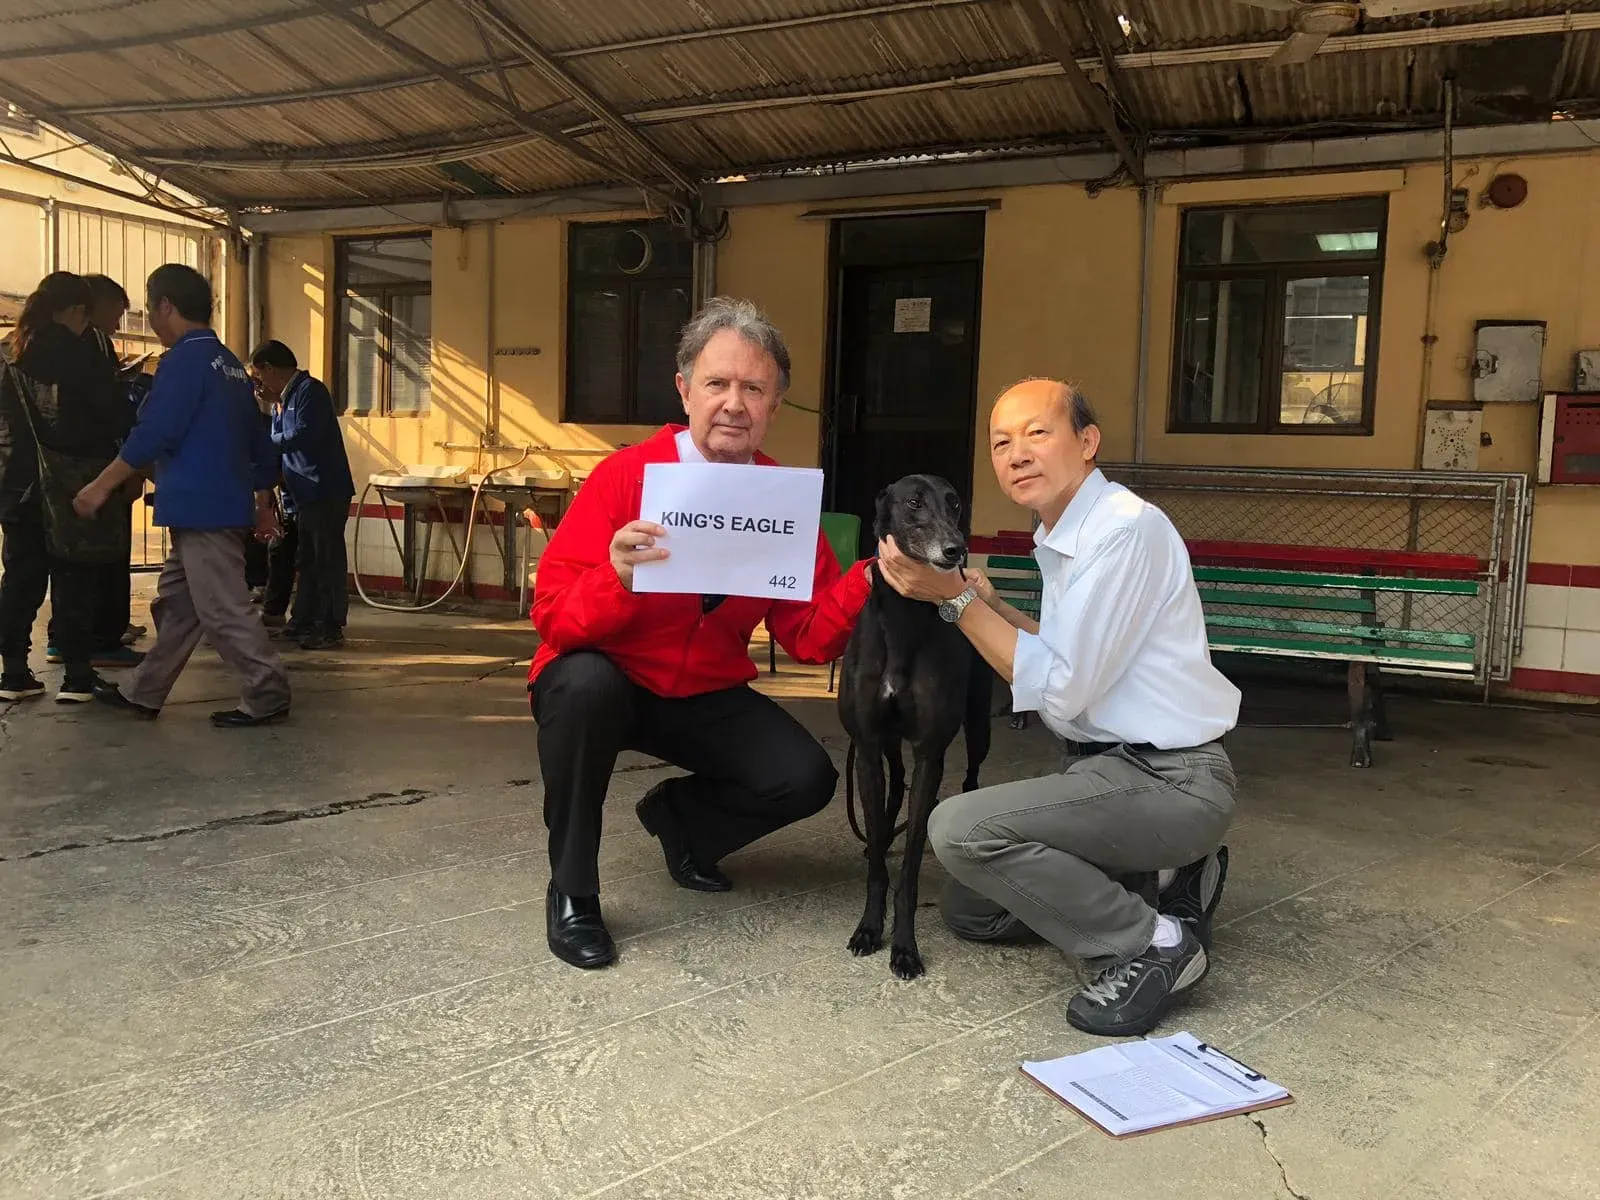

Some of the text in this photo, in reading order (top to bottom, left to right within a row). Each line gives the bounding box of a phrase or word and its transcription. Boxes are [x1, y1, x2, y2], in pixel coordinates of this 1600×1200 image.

[661, 511, 796, 535] KING'S EAGLE
[768, 574, 797, 590] 442
